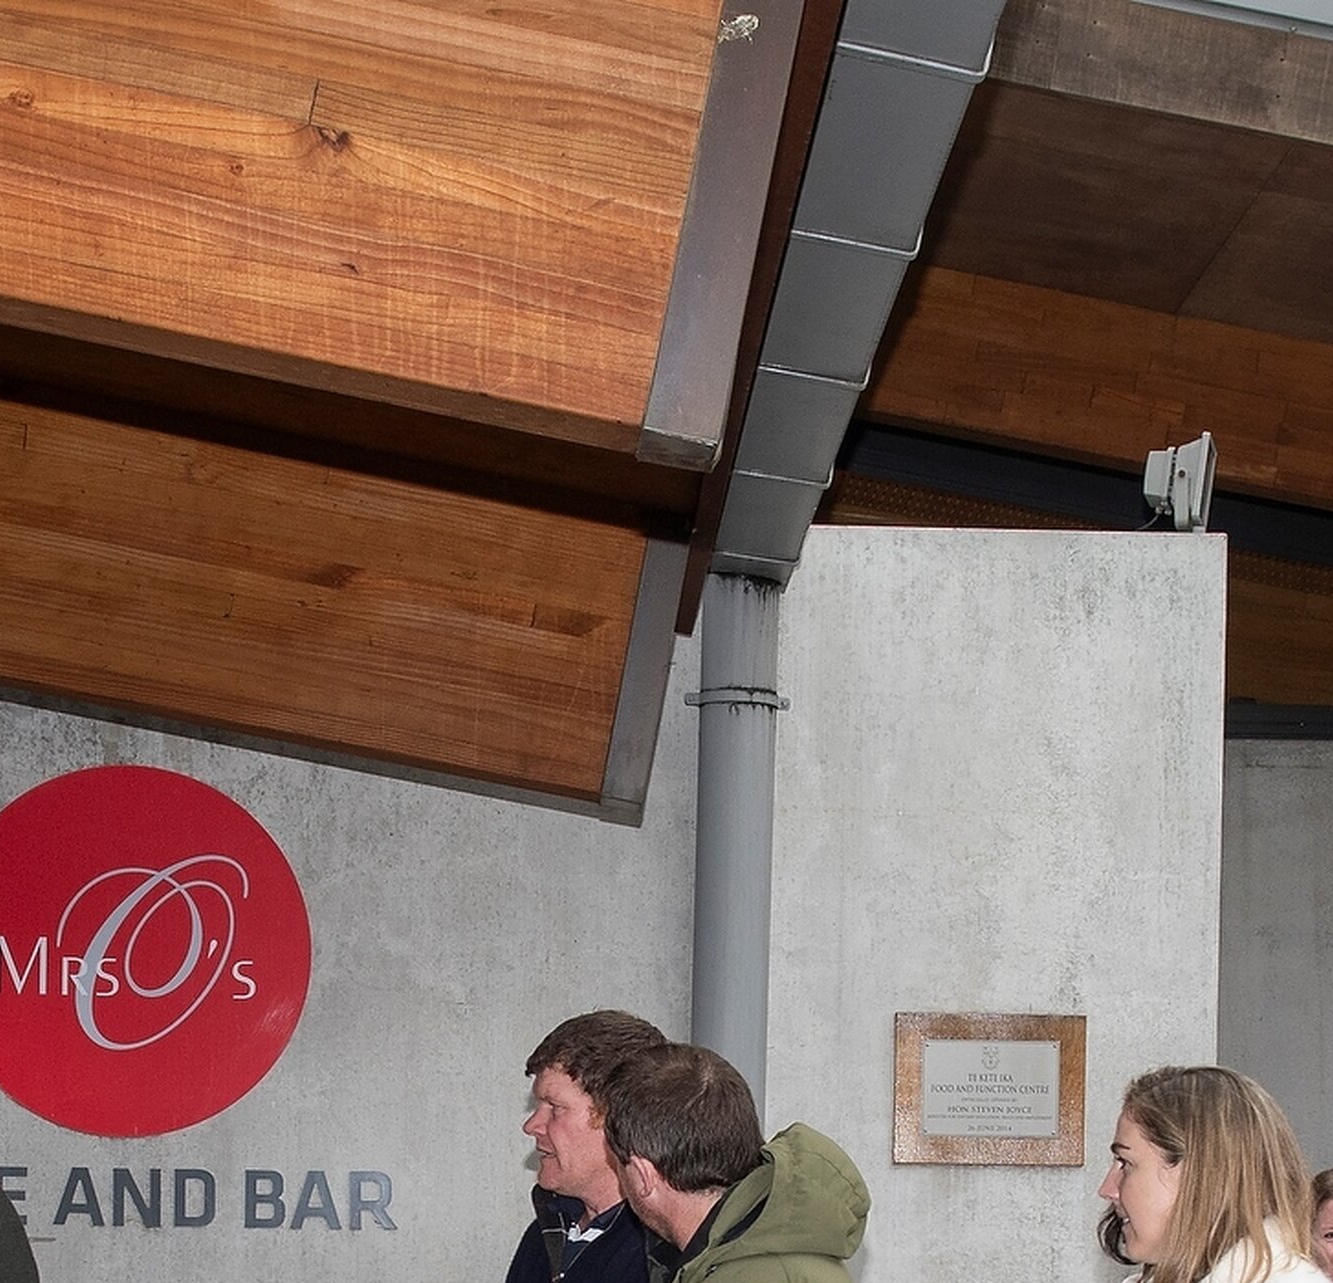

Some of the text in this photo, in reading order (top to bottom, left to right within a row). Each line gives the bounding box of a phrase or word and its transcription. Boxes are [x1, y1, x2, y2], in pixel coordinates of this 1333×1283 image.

[931, 1084, 1050, 1095] FOOD AND FUNCTION CENTRE
[971, 1105, 1004, 1113] STEVEN
[53, 1167, 217, 1229] AND
[244, 1169, 398, 1231] BAR
